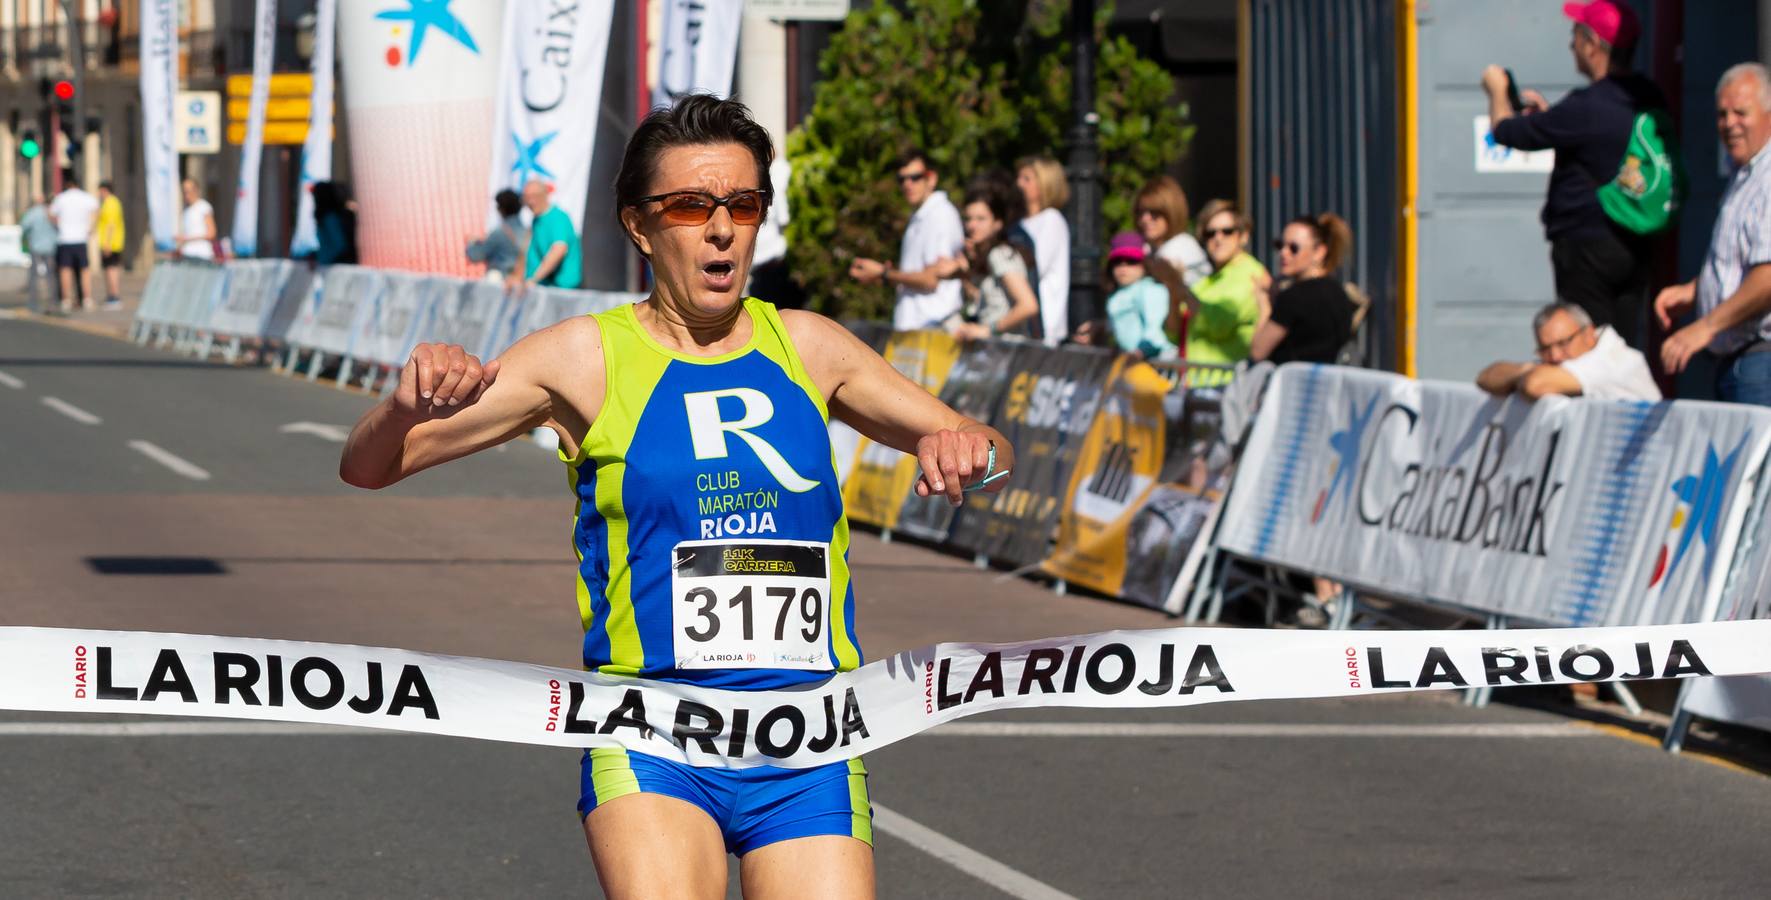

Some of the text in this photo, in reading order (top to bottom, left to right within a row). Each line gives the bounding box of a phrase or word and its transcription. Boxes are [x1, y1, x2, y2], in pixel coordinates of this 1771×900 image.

[684, 387, 821, 493] R
[696, 471, 740, 492] CLUB
[698, 488, 778, 515] MARATÓN
[1358, 404, 1564, 557] CaixaBank
[700, 512, 777, 540] RIOJA
[723, 549, 754, 560] 11K
[724, 560, 796, 572] CARRERA
[684, 585, 822, 643] 3179
[75, 645, 86, 698] DIARIO
[96, 646, 440, 720] LA RIOJA
[703, 654, 743, 662] LA RIOJA
[937, 643, 1235, 711] LA RIOJA
[1345, 647, 1361, 688] DIARIO
[1367, 639, 1713, 688] LA RIOJA
[546, 679, 560, 732] DIARIO
[926, 661, 934, 714] DIARIO
[564, 682, 870, 759] LA RIOJA
